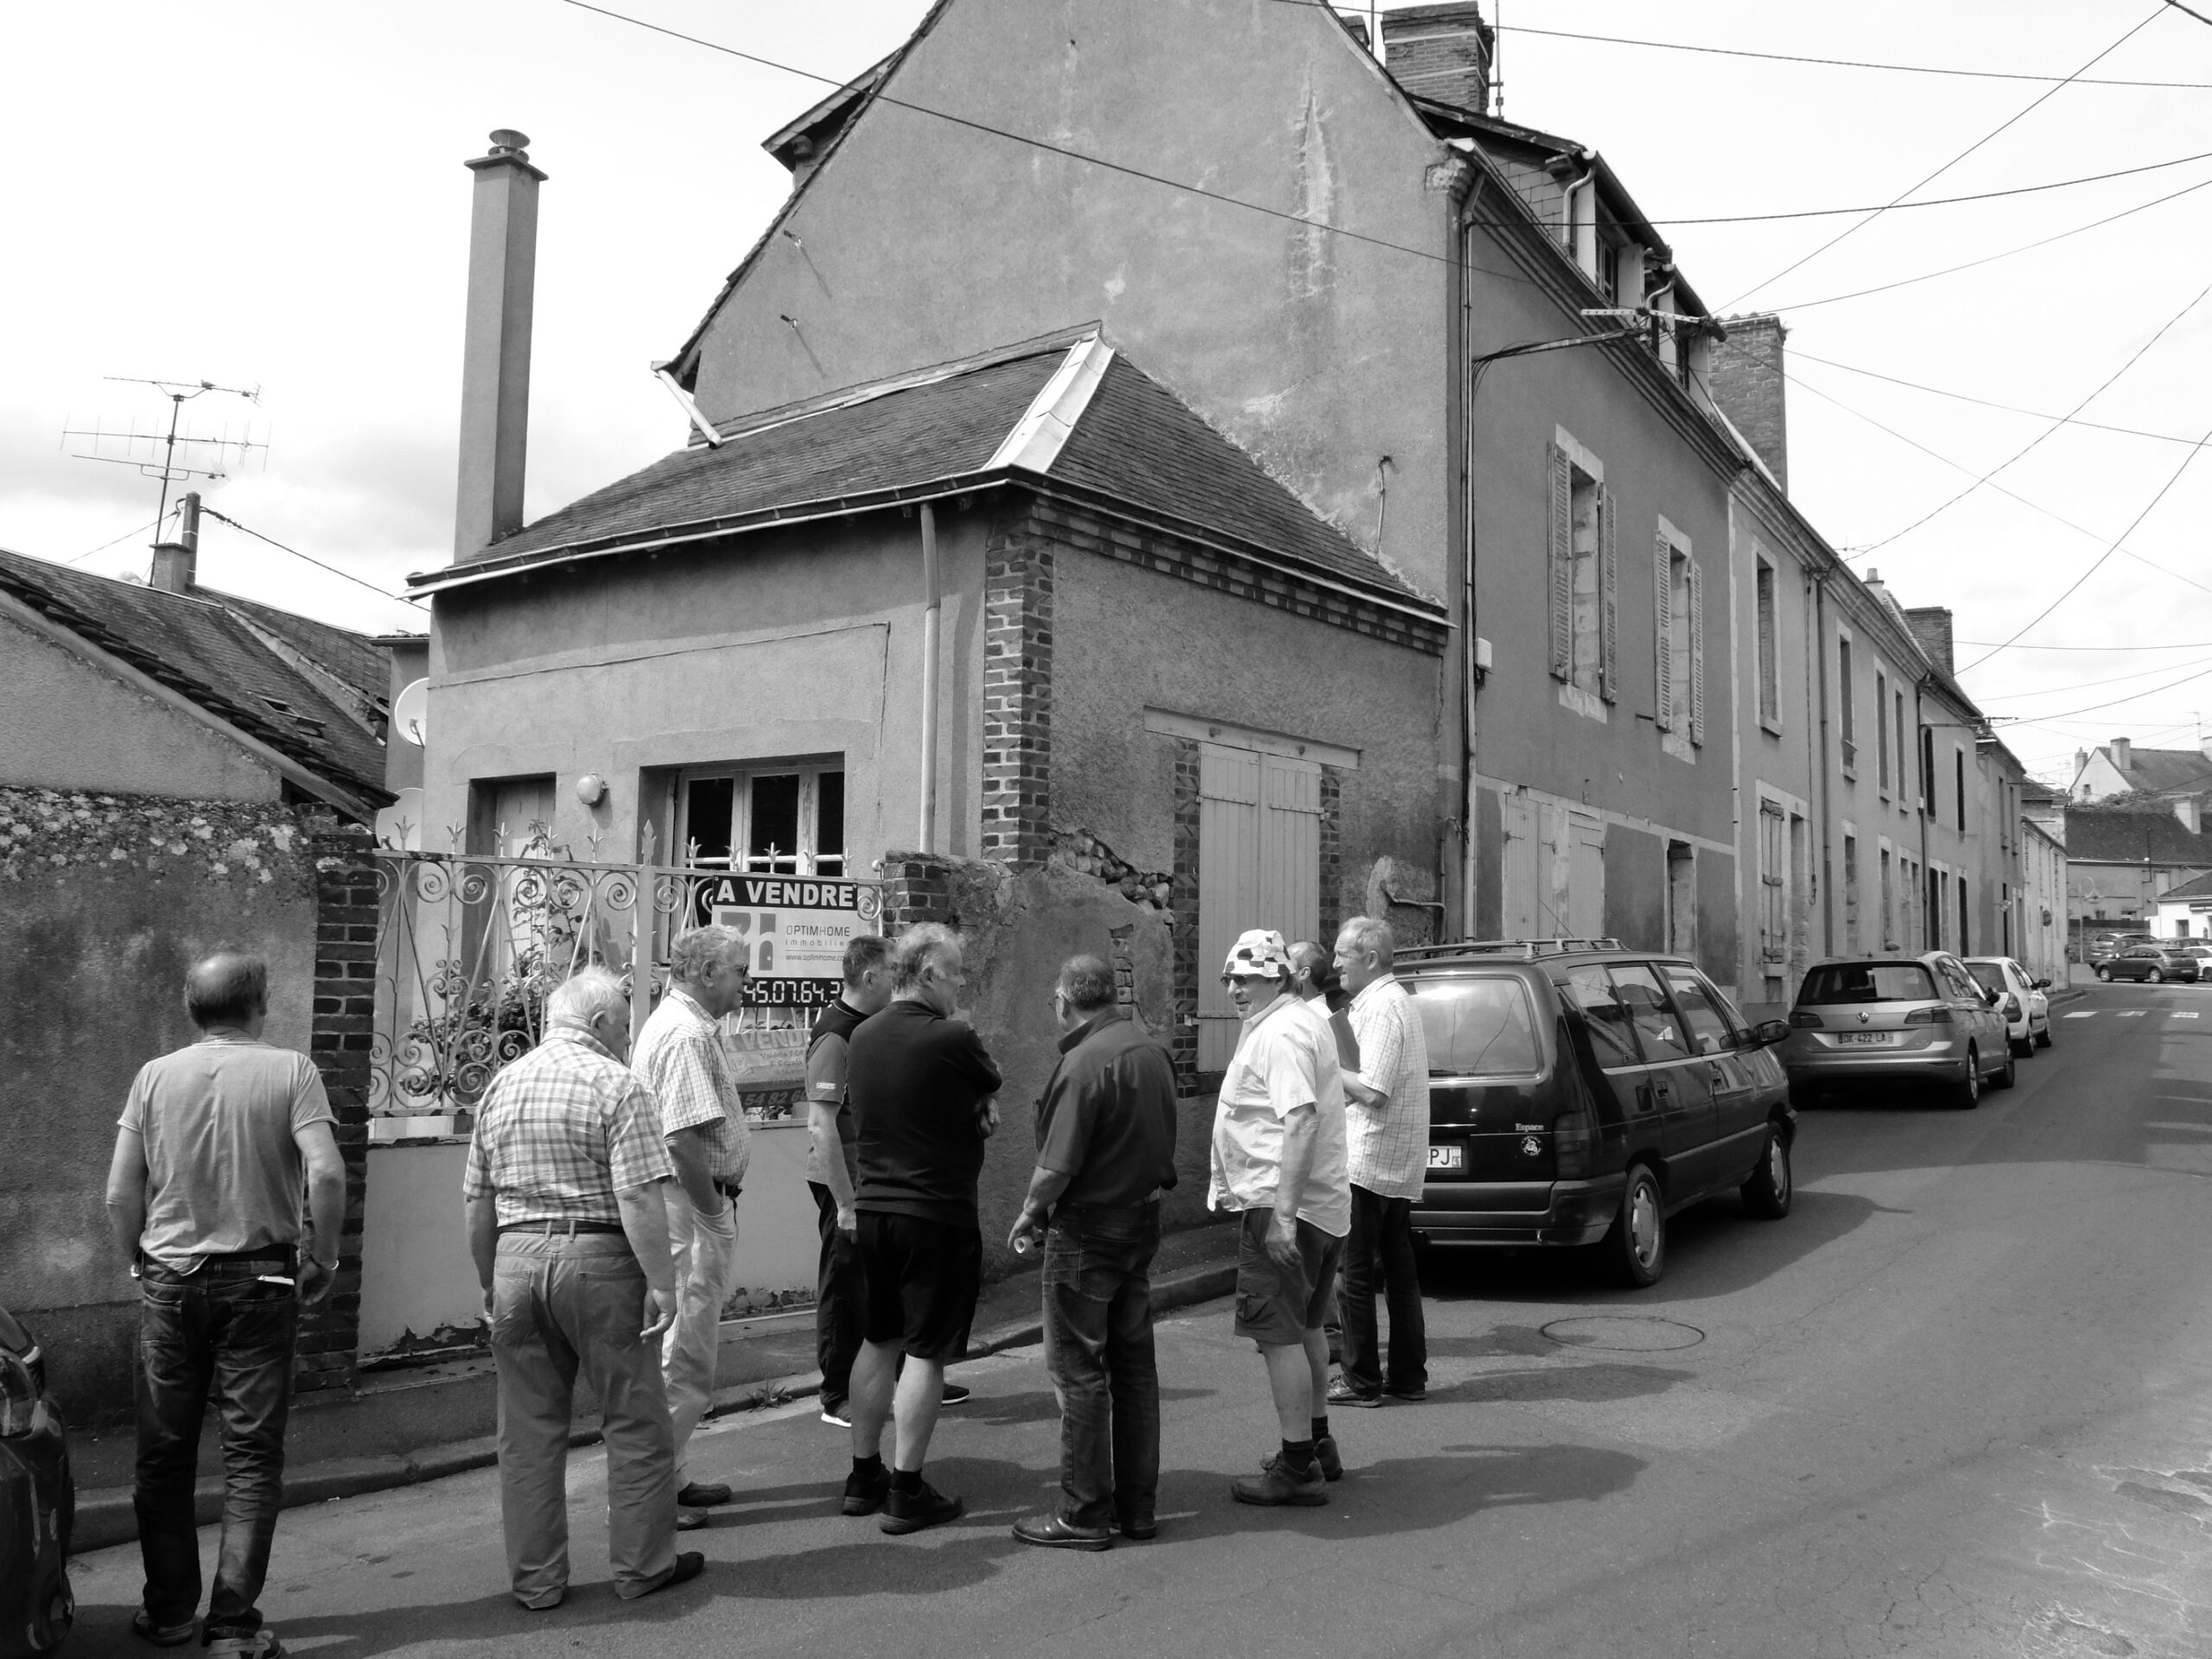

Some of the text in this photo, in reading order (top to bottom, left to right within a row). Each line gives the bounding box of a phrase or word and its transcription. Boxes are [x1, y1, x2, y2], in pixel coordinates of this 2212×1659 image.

[716, 880, 854, 907] A VENDRE
[785, 925, 850, 937] OPTIMHOME
[1515, 1123, 1544, 1132] Espace
